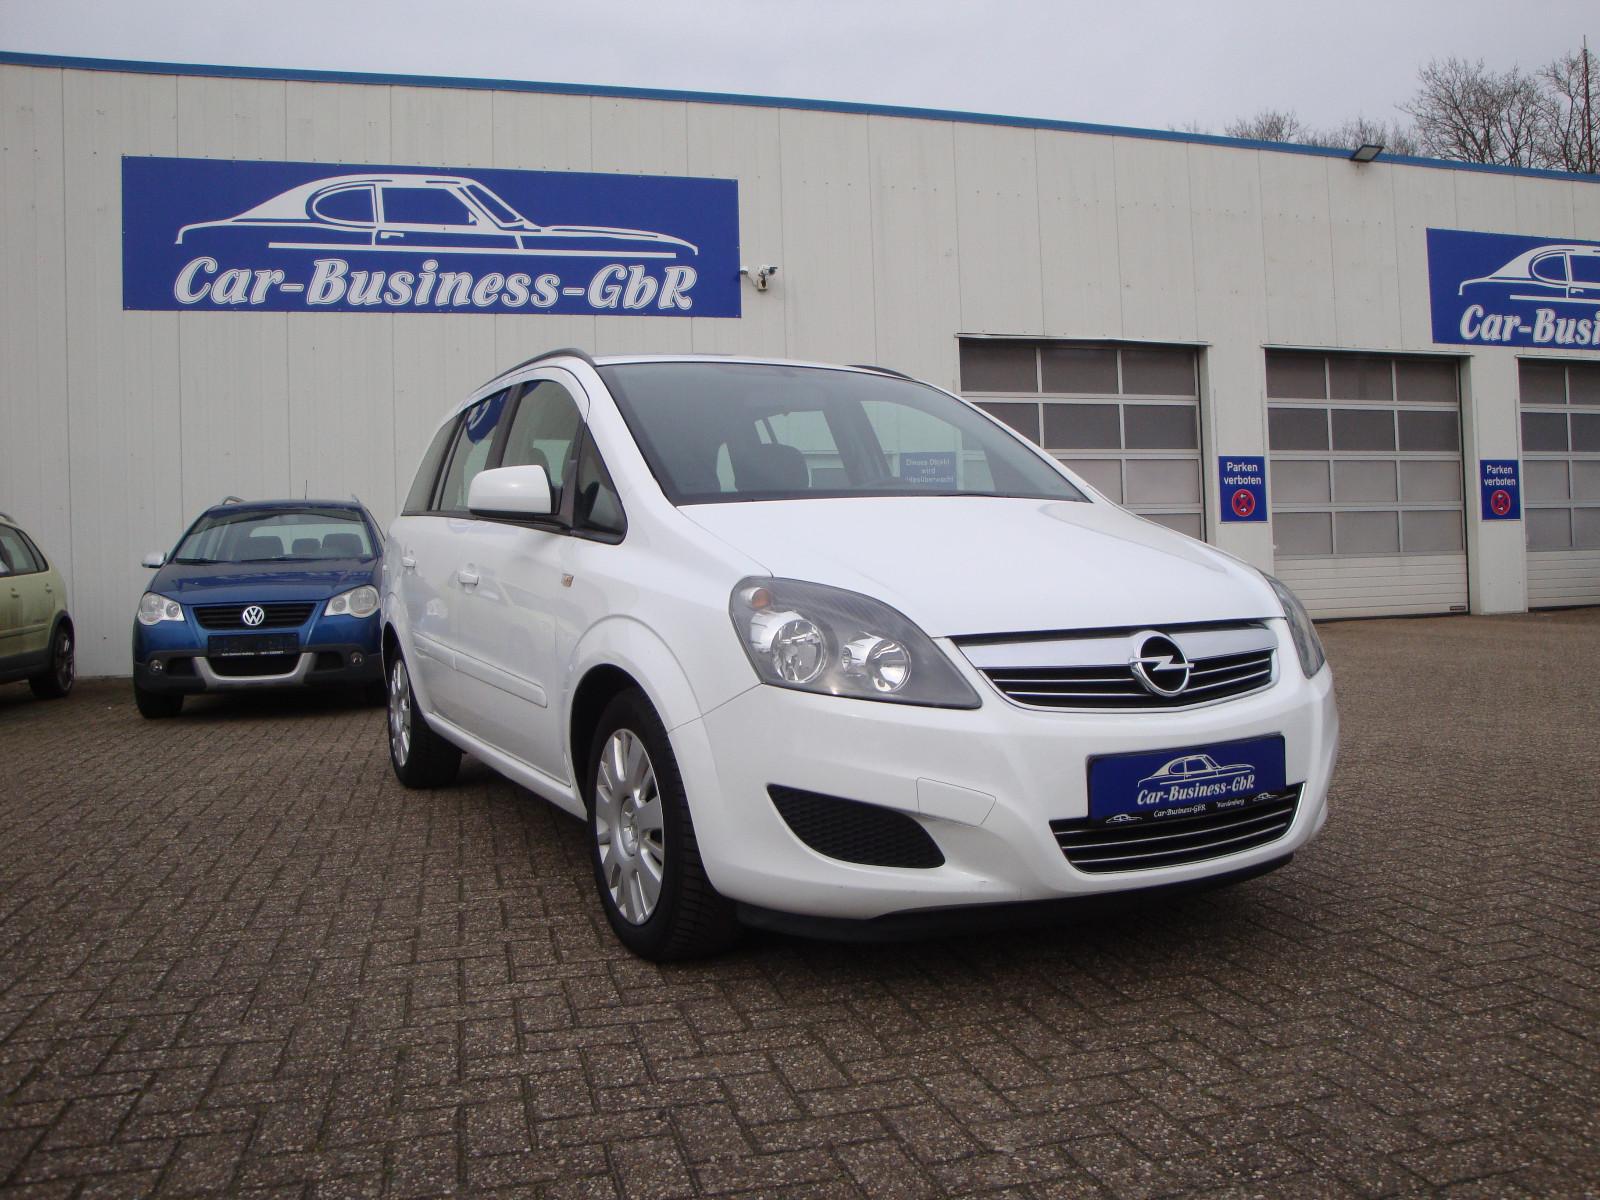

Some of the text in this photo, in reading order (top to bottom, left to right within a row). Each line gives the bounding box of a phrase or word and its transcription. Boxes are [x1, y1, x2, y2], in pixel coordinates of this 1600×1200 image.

[173, 256, 698, 310] Car-Business-GbR
[1226, 461, 1258, 472] Parken
[1486, 464, 1513, 474] Parken
[1223, 474, 1262, 485] verboten
[1483, 476, 1516, 486] verboten
[1137, 774, 1255, 805] Car-Business-GbR
